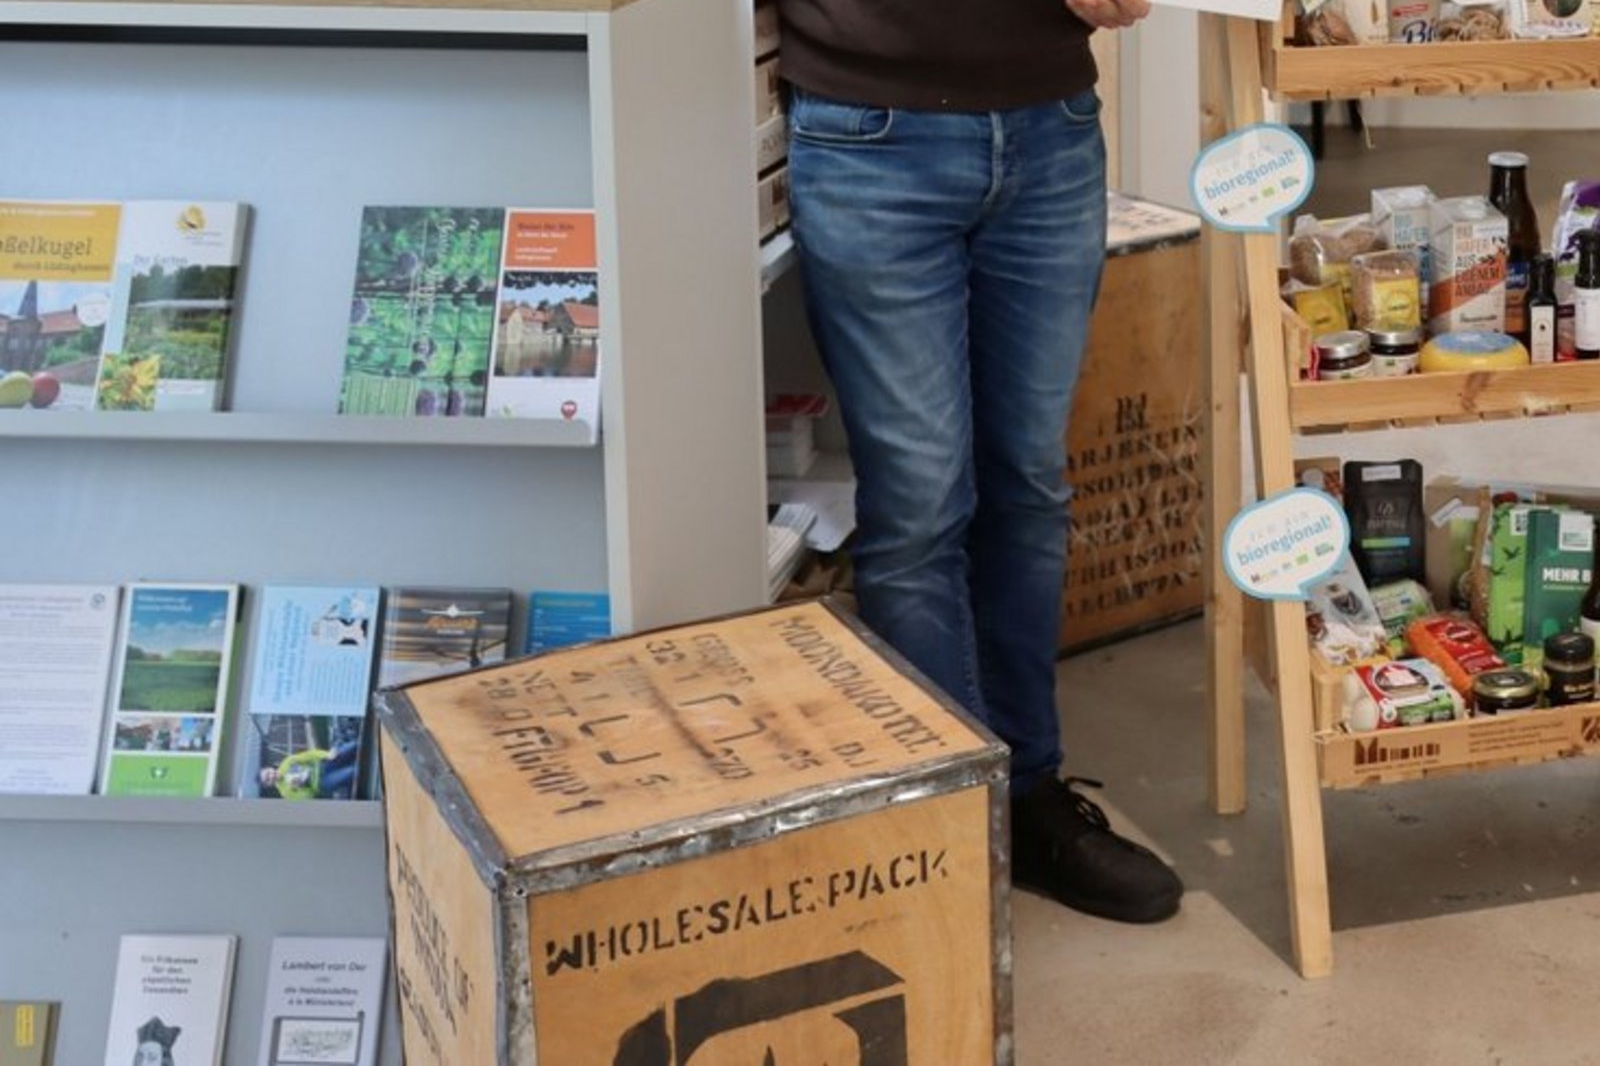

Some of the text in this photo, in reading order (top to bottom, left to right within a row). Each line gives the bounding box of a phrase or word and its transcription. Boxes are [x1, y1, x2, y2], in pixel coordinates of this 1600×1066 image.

[0, 235, 93, 258] ßelkugel
[1236, 514, 1332, 566] bioregional!
[1542, 567, 1580, 582] MEHR
[546, 875, 817, 976] WHOLESALE
[828, 848, 949, 908] PACK
